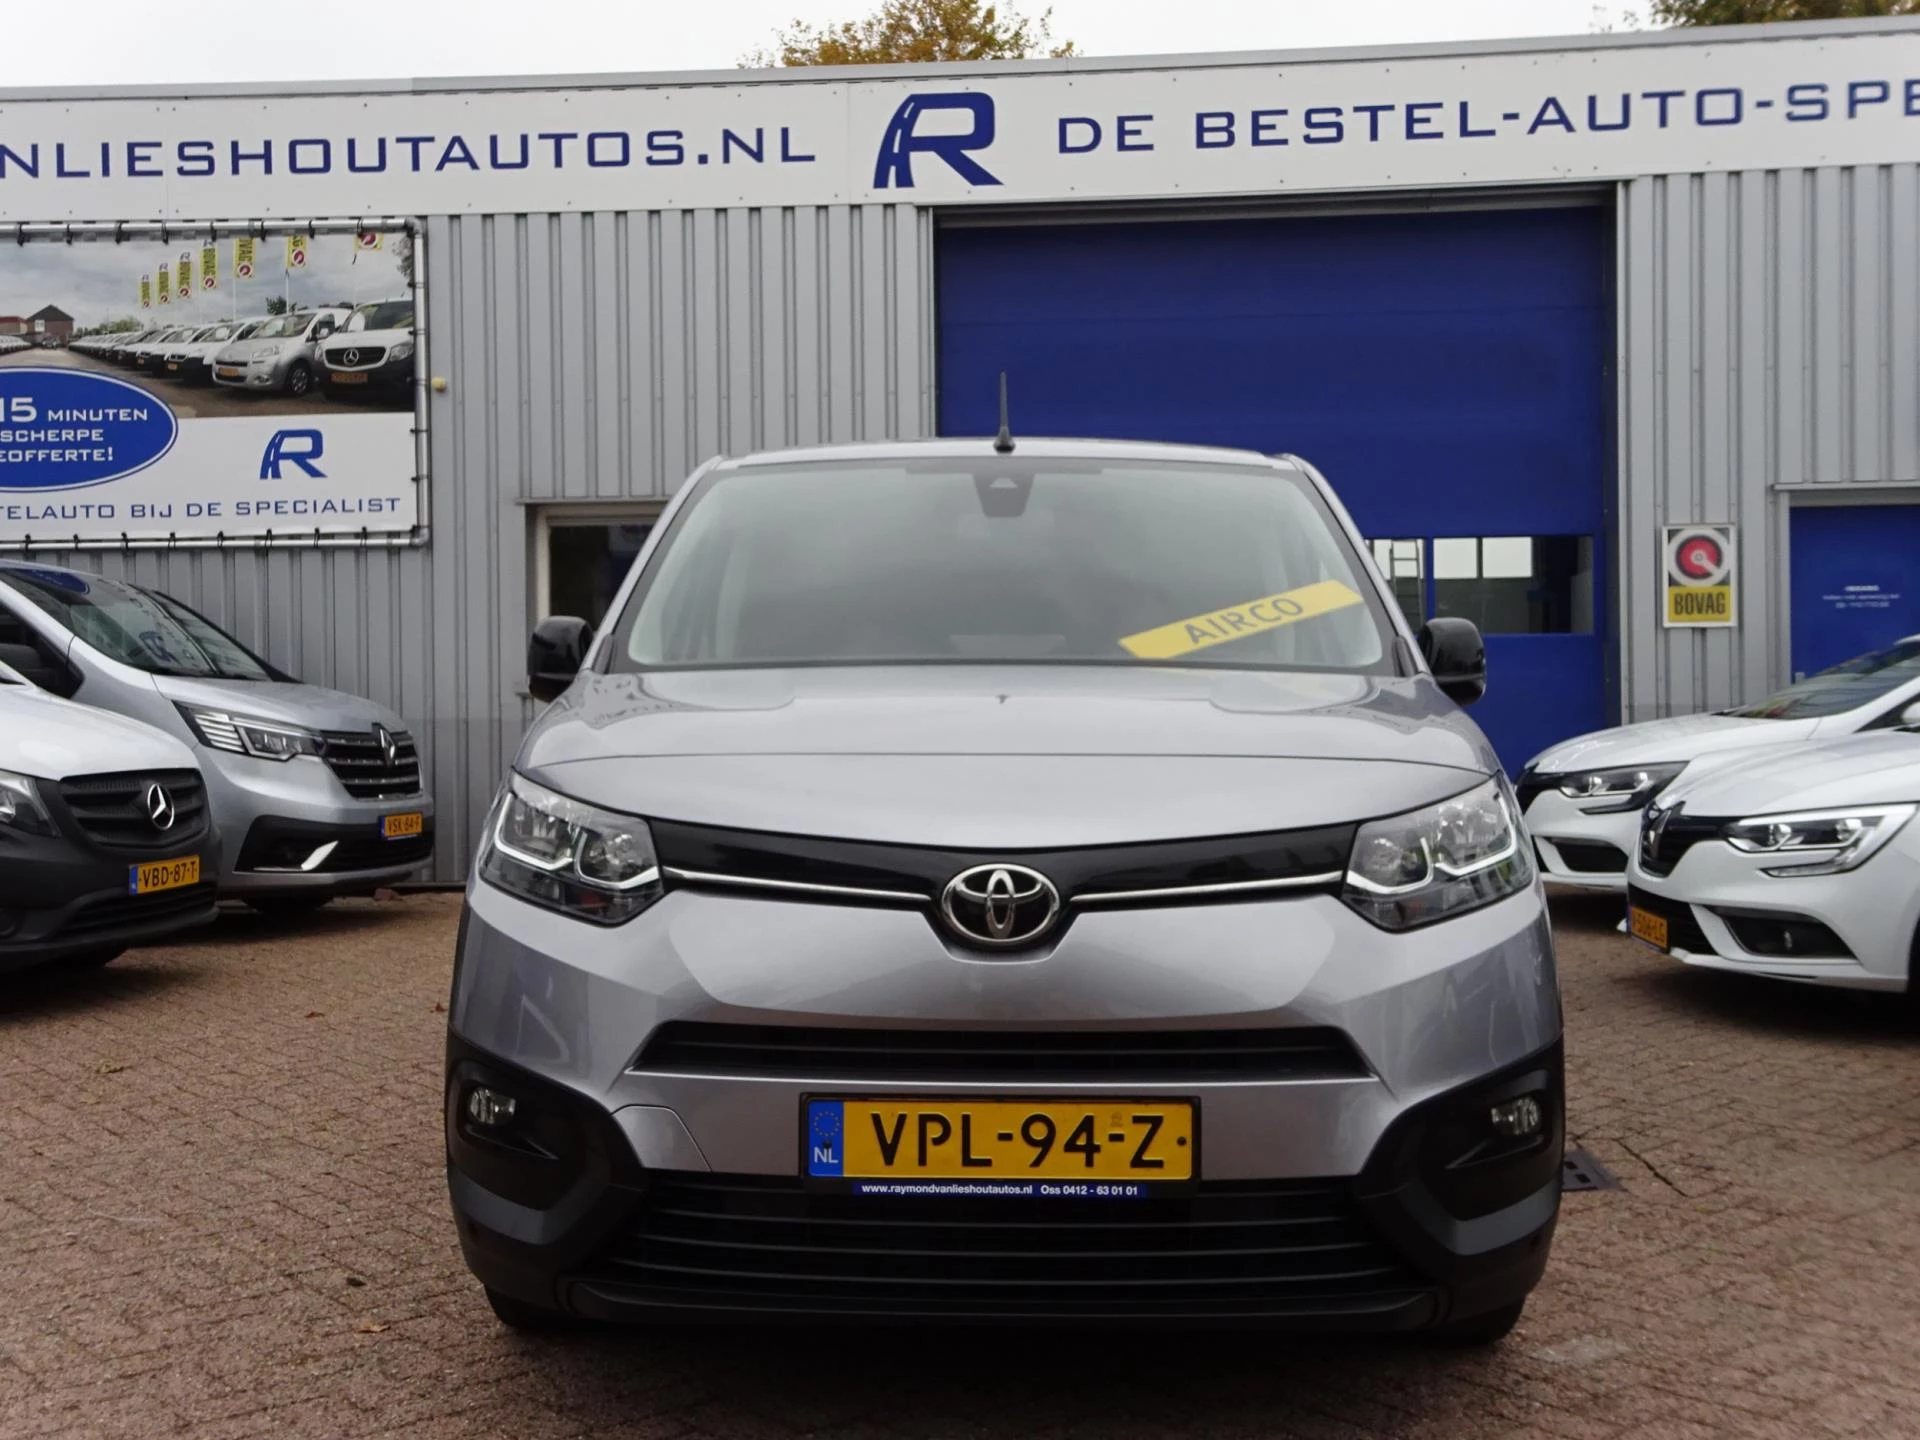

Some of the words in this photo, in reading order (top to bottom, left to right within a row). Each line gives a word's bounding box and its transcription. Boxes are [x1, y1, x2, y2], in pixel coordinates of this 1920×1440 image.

[1058, 114, 1155, 153] DE
[0, 127, 815, 179] NLIESHOUTAUTOS.NL
[48, 408, 148, 422] MINUTEN
[0, 429, 104, 443] SCHERPE
[131, 503, 172, 518] BIJ
[187, 502, 222, 517] DE
[236, 498, 400, 516] SPECIALIST
[1673, 592, 1726, 616] BOVAG
[1184, 597, 1304, 645] AIRCO
[142, 860, 197, 889] VBD-87-T
[870, 1111, 1165, 1169] VPL-94-Z
[814, 1146, 839, 1164] NL
[861, 1183, 1033, 1196] www.raymondvanlieshoutautos.nl
[1040, 1184, 1061, 1195] Oss
[1063, 1185, 1087, 1195] 0412
[1096, 1186, 1110, 1196] 63
[1111, 1186, 1123, 1196] 01
[1125, 1186, 1138, 1196] 01
